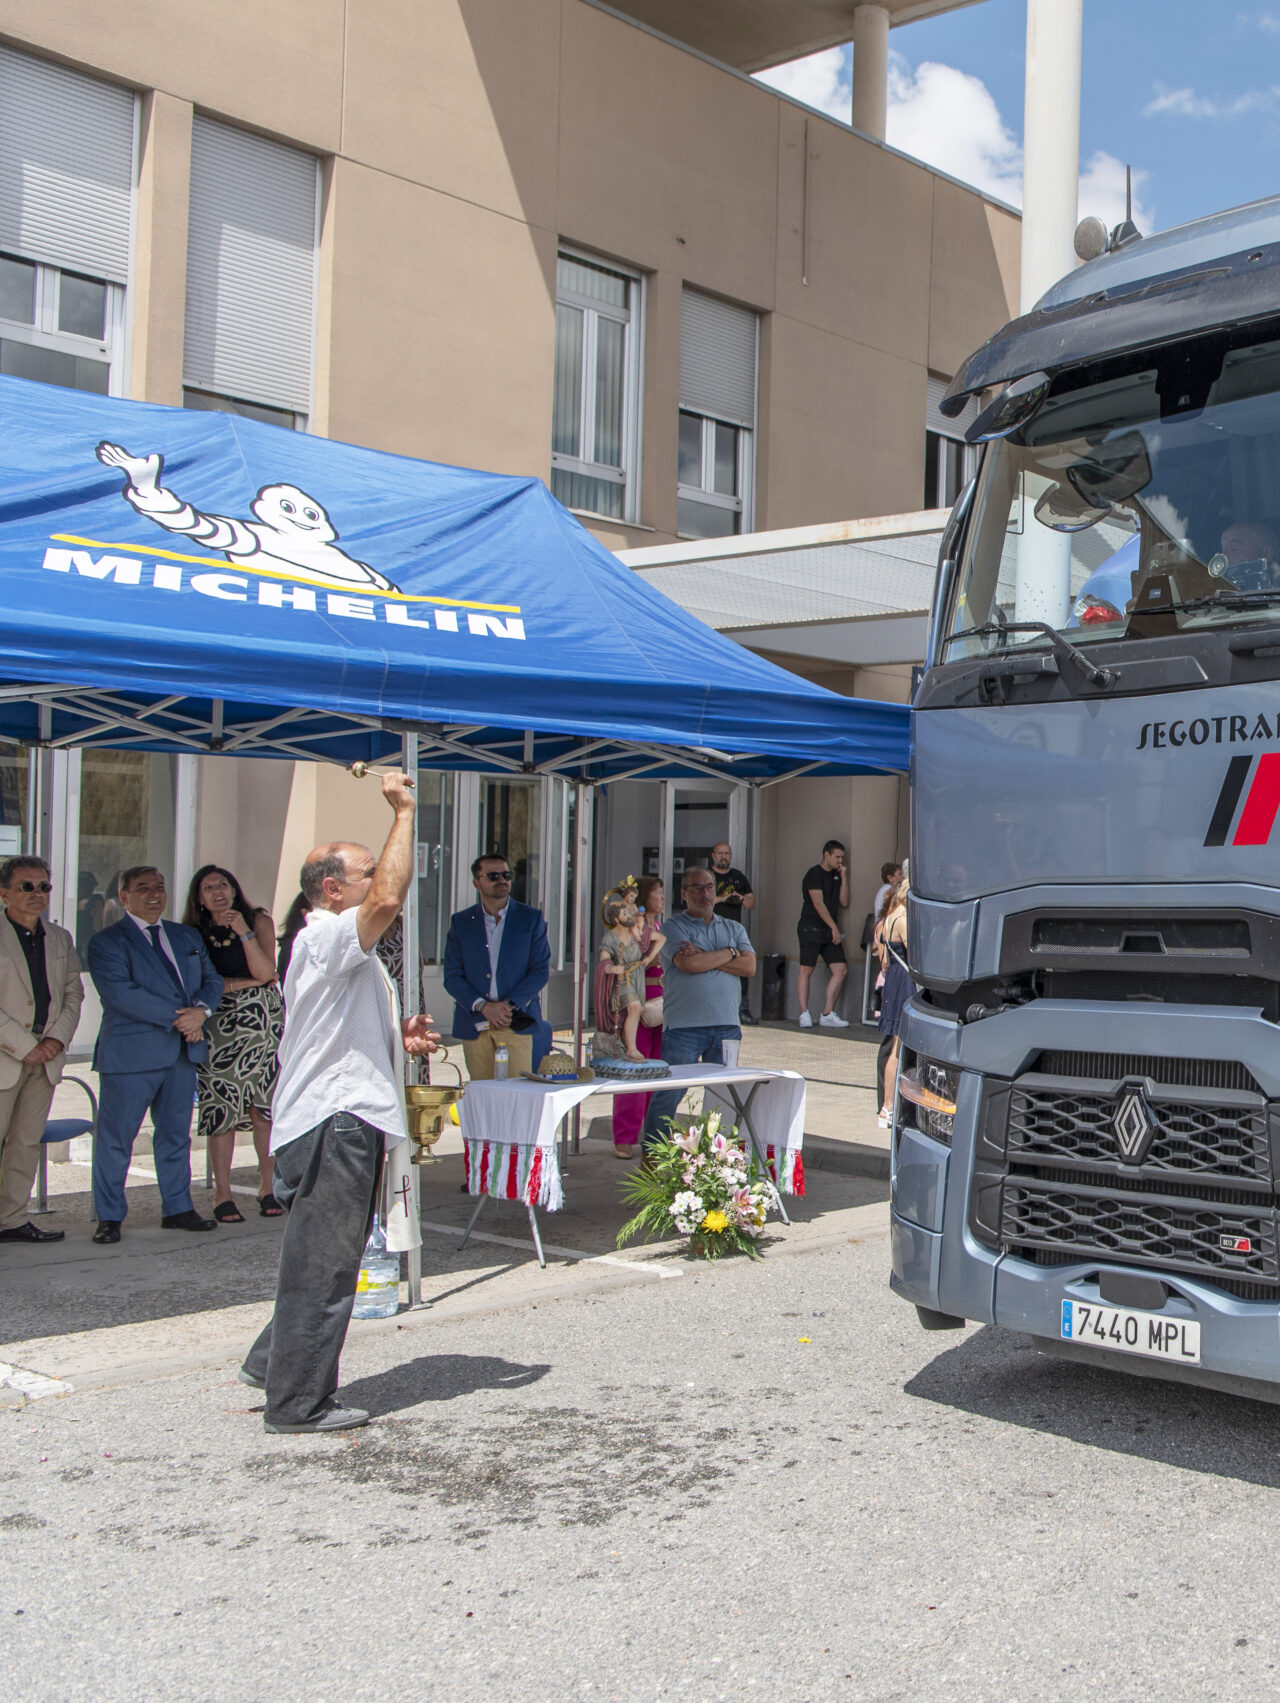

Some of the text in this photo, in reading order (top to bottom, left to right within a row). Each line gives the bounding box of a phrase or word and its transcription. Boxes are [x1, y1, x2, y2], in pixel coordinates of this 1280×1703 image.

[42, 547, 527, 641] MICHELIN
[1078, 1306, 1139, 1346] 7440
[1148, 1319, 1196, 1358] MPL
